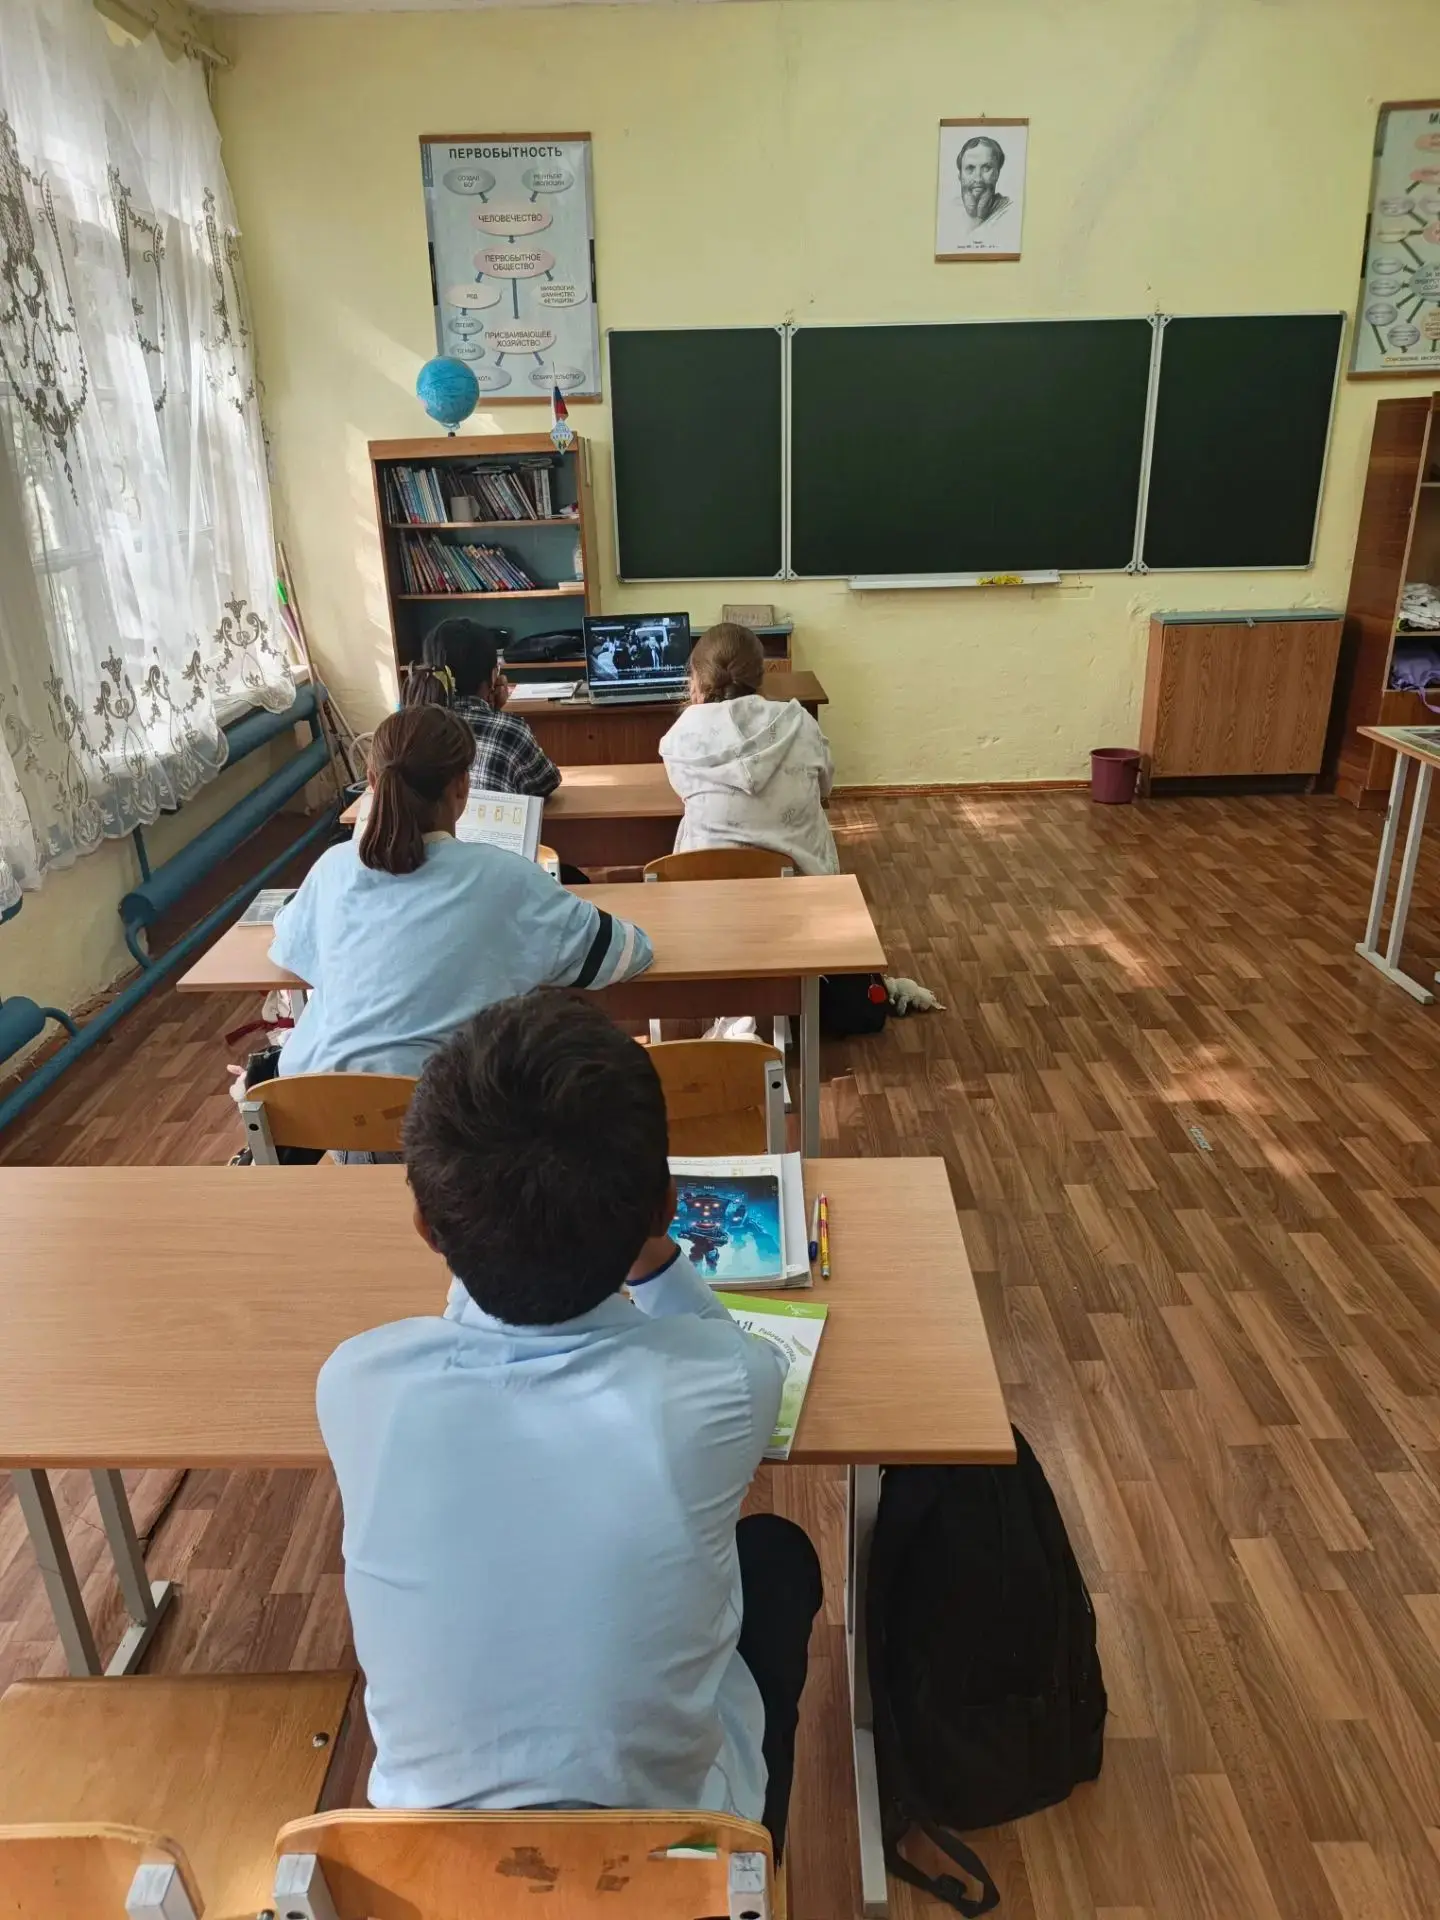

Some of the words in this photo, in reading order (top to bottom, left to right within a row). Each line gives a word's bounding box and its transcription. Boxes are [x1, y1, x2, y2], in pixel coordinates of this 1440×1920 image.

[449, 147, 562, 159] ПЕРВОБЫТНОСТЬ
[478, 213, 543, 223] ЧЕЛОВЕЧЕСТВО
[485, 254, 541, 263] ПЕРВОБЫТНОЕ
[493, 263, 535, 271] ОБЩЕСТВО
[485, 331, 552, 340] ПРИСВАИВАЮЩЕЕ
[497, 339, 541, 348] ХОЗЯЙСТВО
